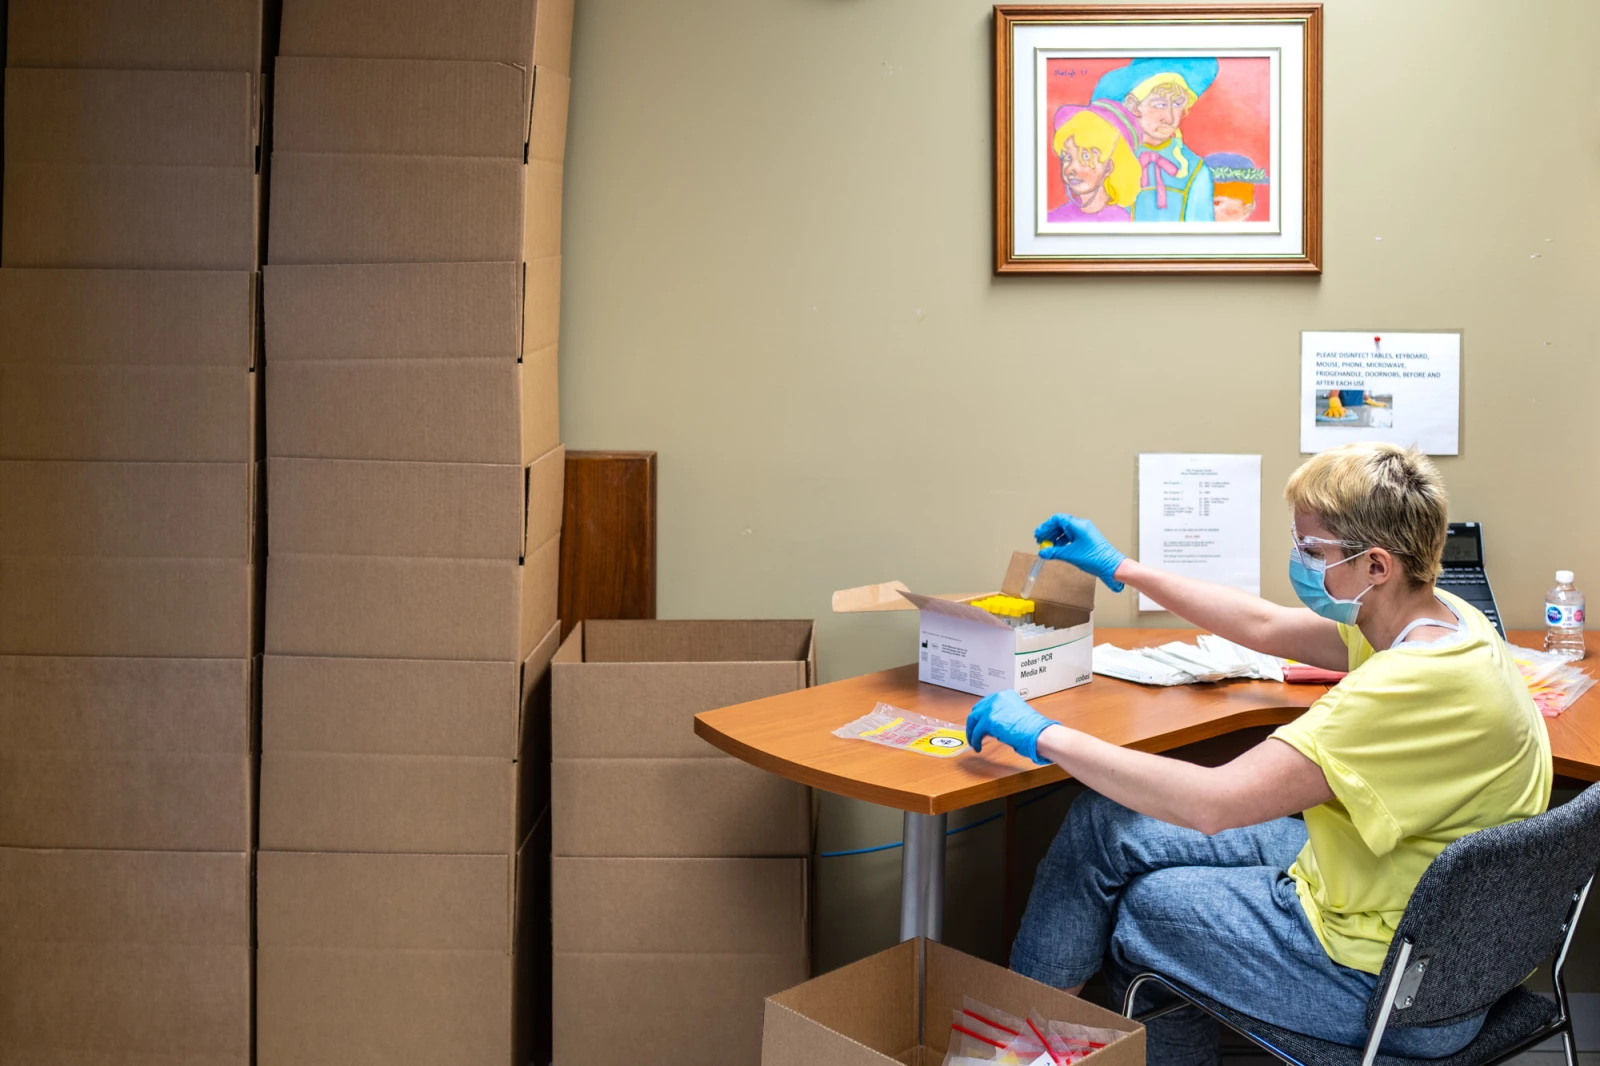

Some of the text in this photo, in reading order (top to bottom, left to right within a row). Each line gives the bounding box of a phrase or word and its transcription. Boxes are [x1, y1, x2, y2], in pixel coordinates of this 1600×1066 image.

[1041, 652, 1053, 662] PCR
[1020, 665, 1047, 679] Media Kit
